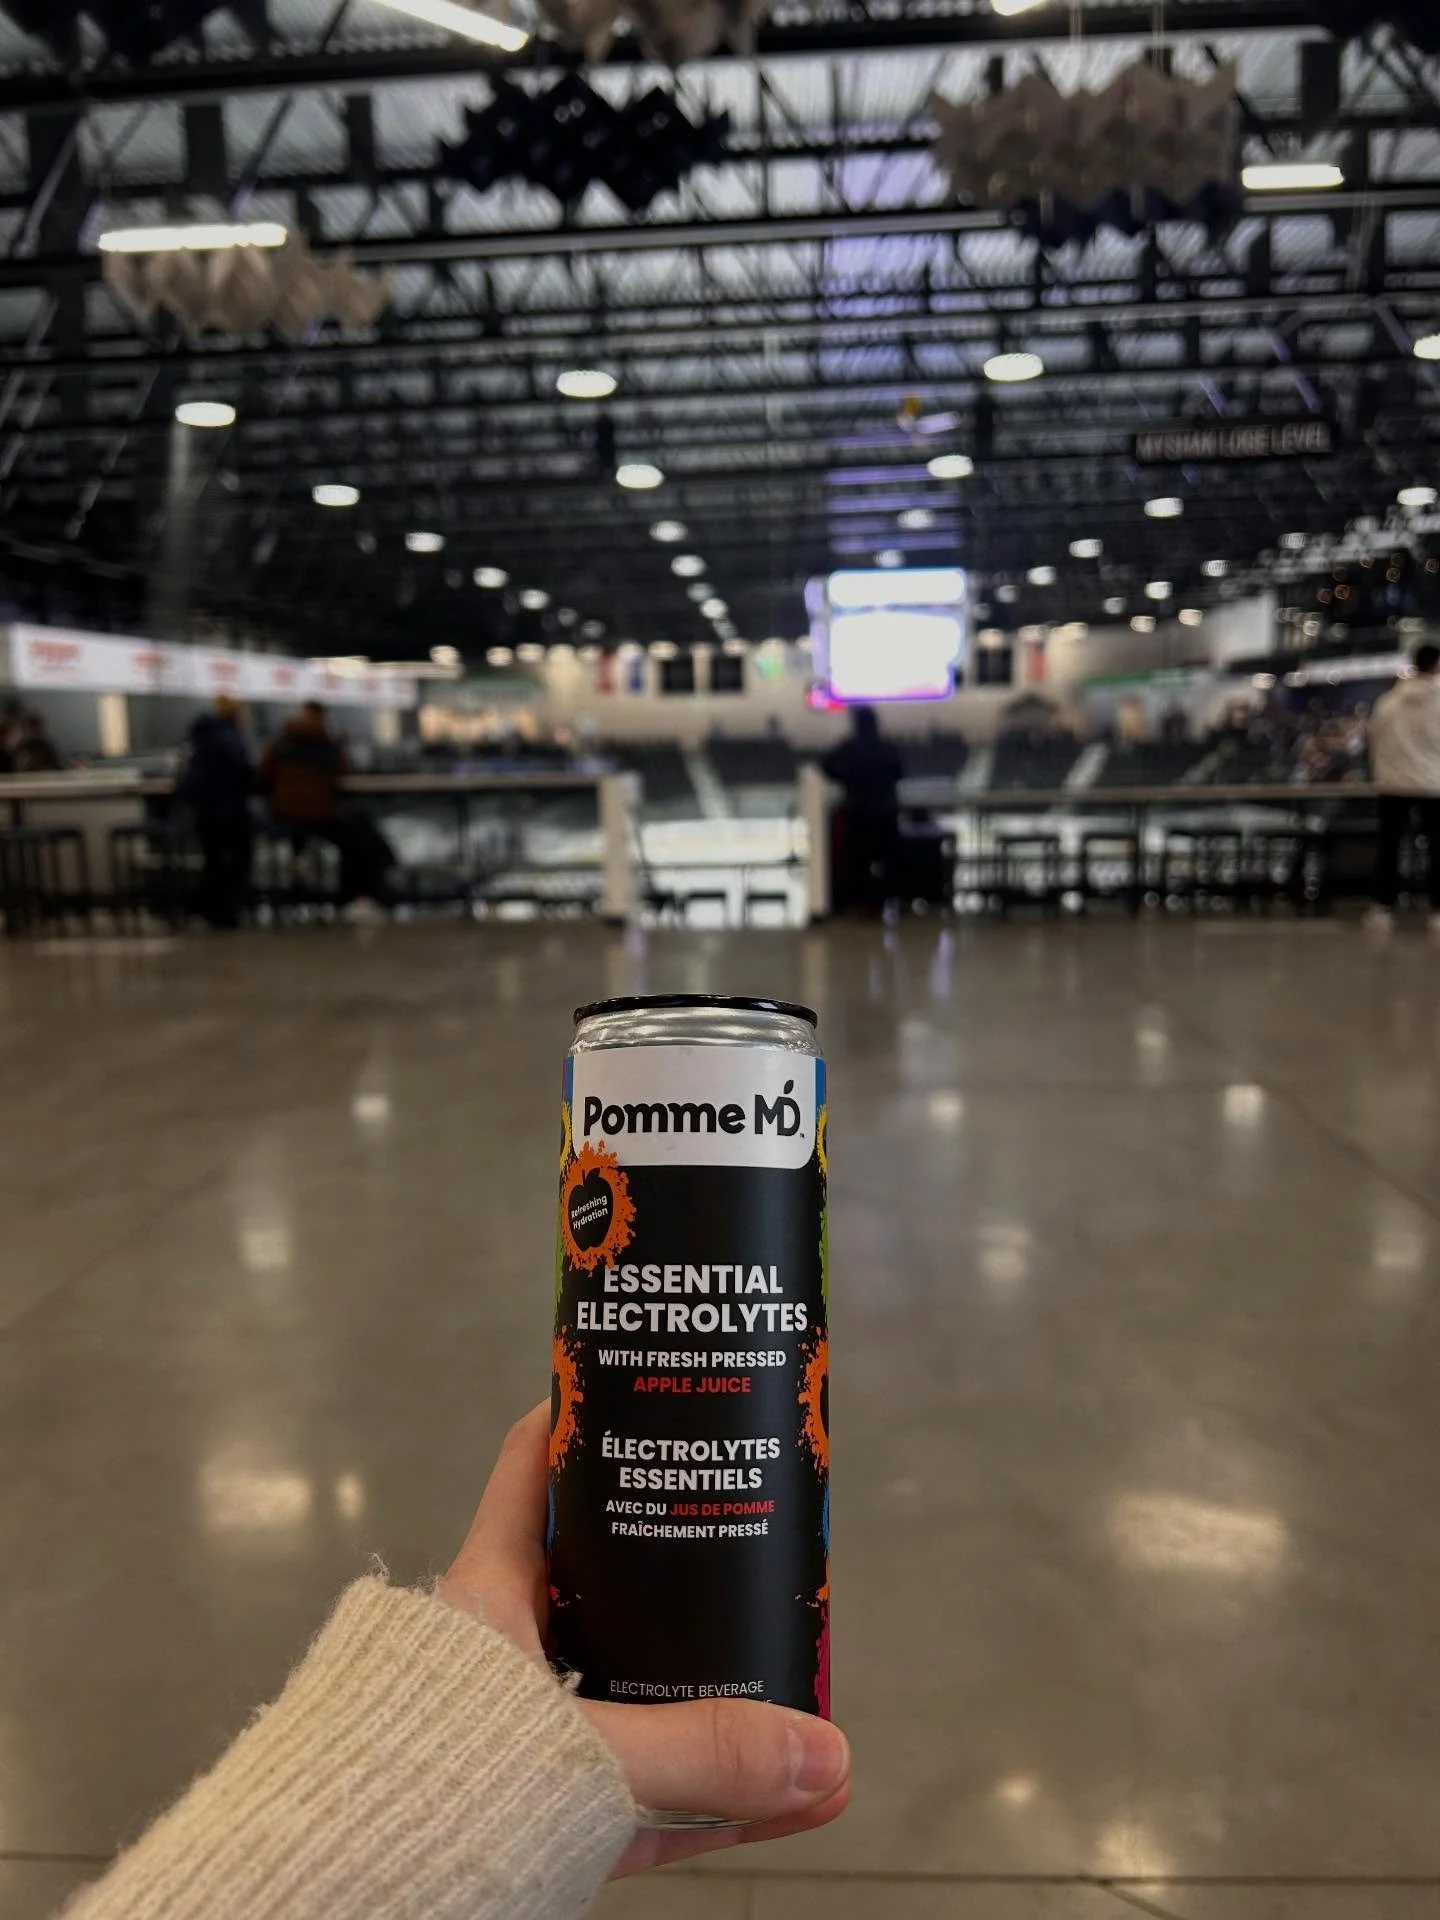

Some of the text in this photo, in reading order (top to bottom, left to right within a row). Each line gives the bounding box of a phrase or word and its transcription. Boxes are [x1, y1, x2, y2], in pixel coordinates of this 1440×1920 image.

[1272, 423, 1330, 454] LEVEL
[584, 1096, 746, 1136] Pomme
[571, 1195, 608, 1219] Refreshing
[573, 1208, 609, 1230] Hydration
[603, 1264, 784, 1294] ESSENTIAL
[577, 1302, 808, 1333] ELECTROLYTES
[598, 1350, 787, 1368] WITH FRESH PRESSED
[633, 1377, 752, 1394] APPLE JUICE
[601, 1430, 781, 1462] ÉLECTROLYTES
[619, 1467, 763, 1491] ESSENTIELS
[606, 1500, 775, 1516] AVEC DU JUS DE POMME
[611, 1519, 769, 1538] FRAÎCHEMENT PRESSÉ
[610, 1680, 765, 1697] ELECTROLYTE BEVERAGE
